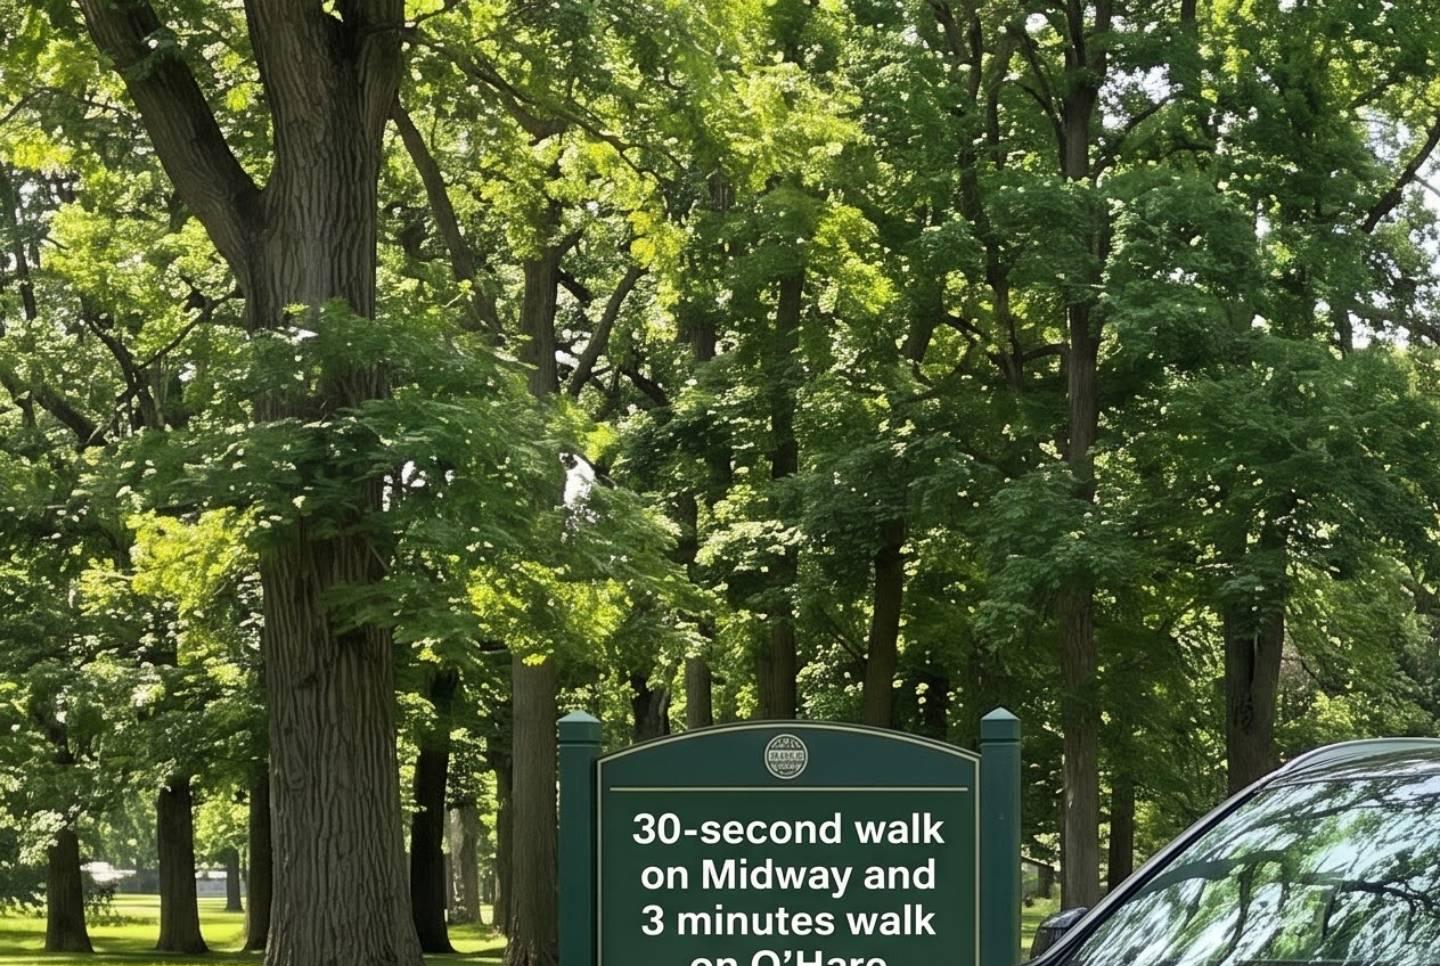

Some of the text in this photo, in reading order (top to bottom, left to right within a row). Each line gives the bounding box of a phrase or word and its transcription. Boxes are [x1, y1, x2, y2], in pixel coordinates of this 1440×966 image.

[632, 812, 945, 845] 30-second walk
[640, 857, 935, 899] on Midway and
[641, 903, 937, 936] 3 minutes walk
